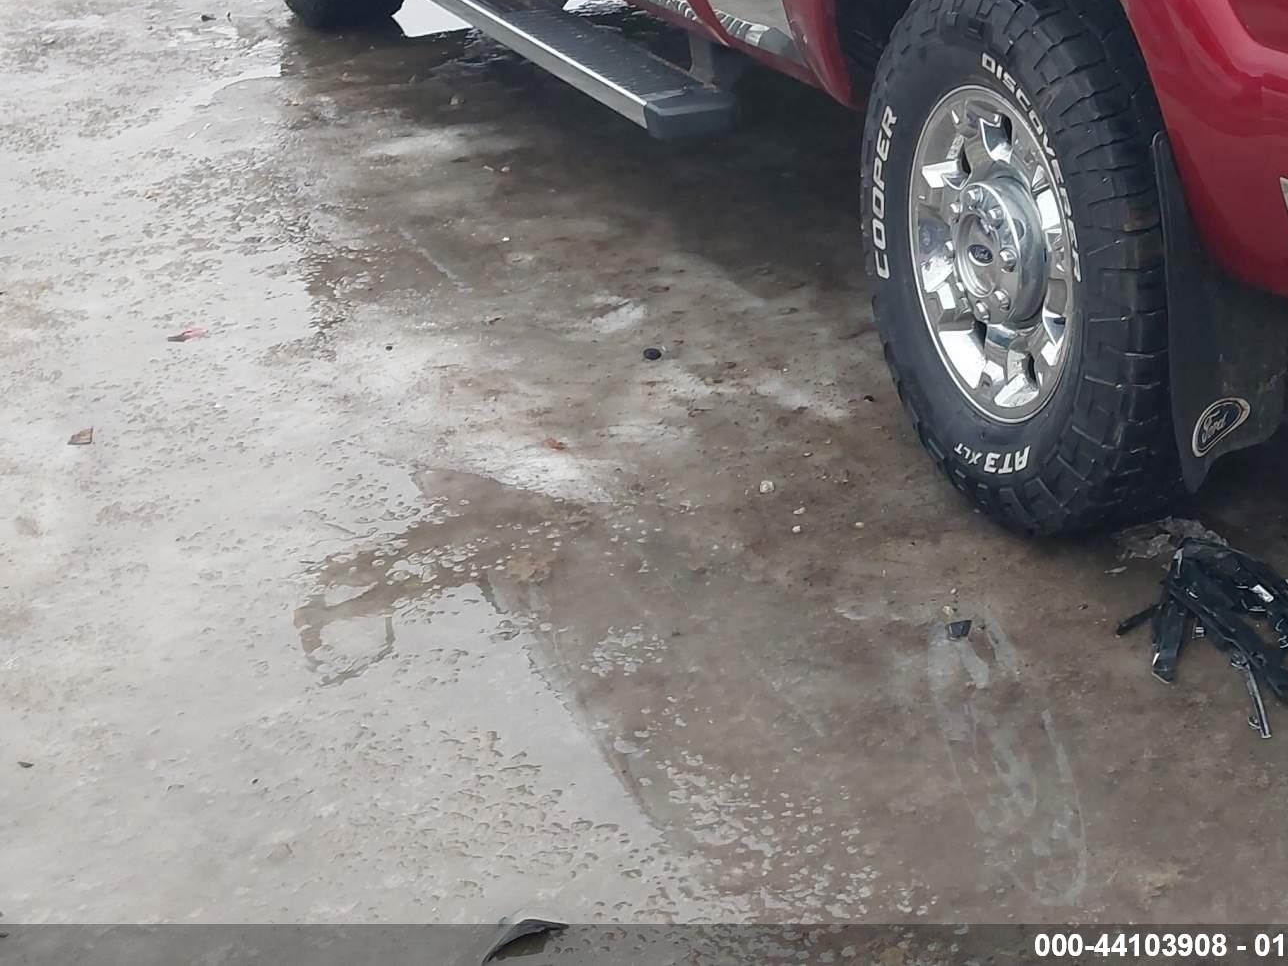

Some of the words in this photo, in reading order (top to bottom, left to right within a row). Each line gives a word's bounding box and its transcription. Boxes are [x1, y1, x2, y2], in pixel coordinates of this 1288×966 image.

[872, 105, 898, 279] COOPER
[1201, 410, 1228, 443] Ford
[983, 445, 1031, 474] AT3
